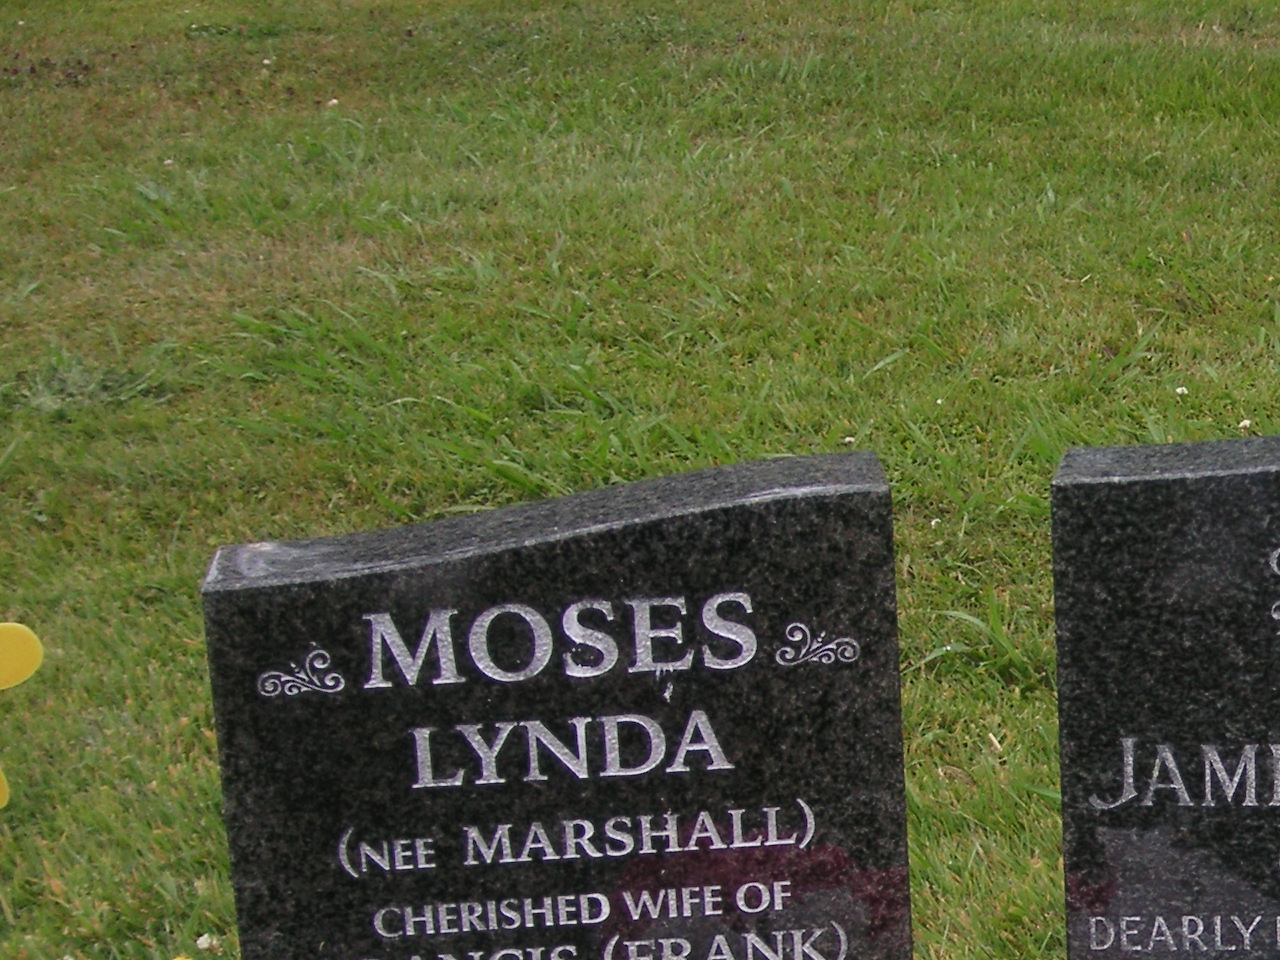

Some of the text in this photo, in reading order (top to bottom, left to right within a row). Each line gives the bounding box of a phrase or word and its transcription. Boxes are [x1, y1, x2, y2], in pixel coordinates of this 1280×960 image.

[361, 592, 760, 691] MOSES
[408, 710, 735, 789] LYNDA
[338, 797, 817, 878] (NEE MARSHALL)
[373, 880, 793, 939] CHERISHED WIFE OF
[1089, 914, 1264, 952] DEARLY
